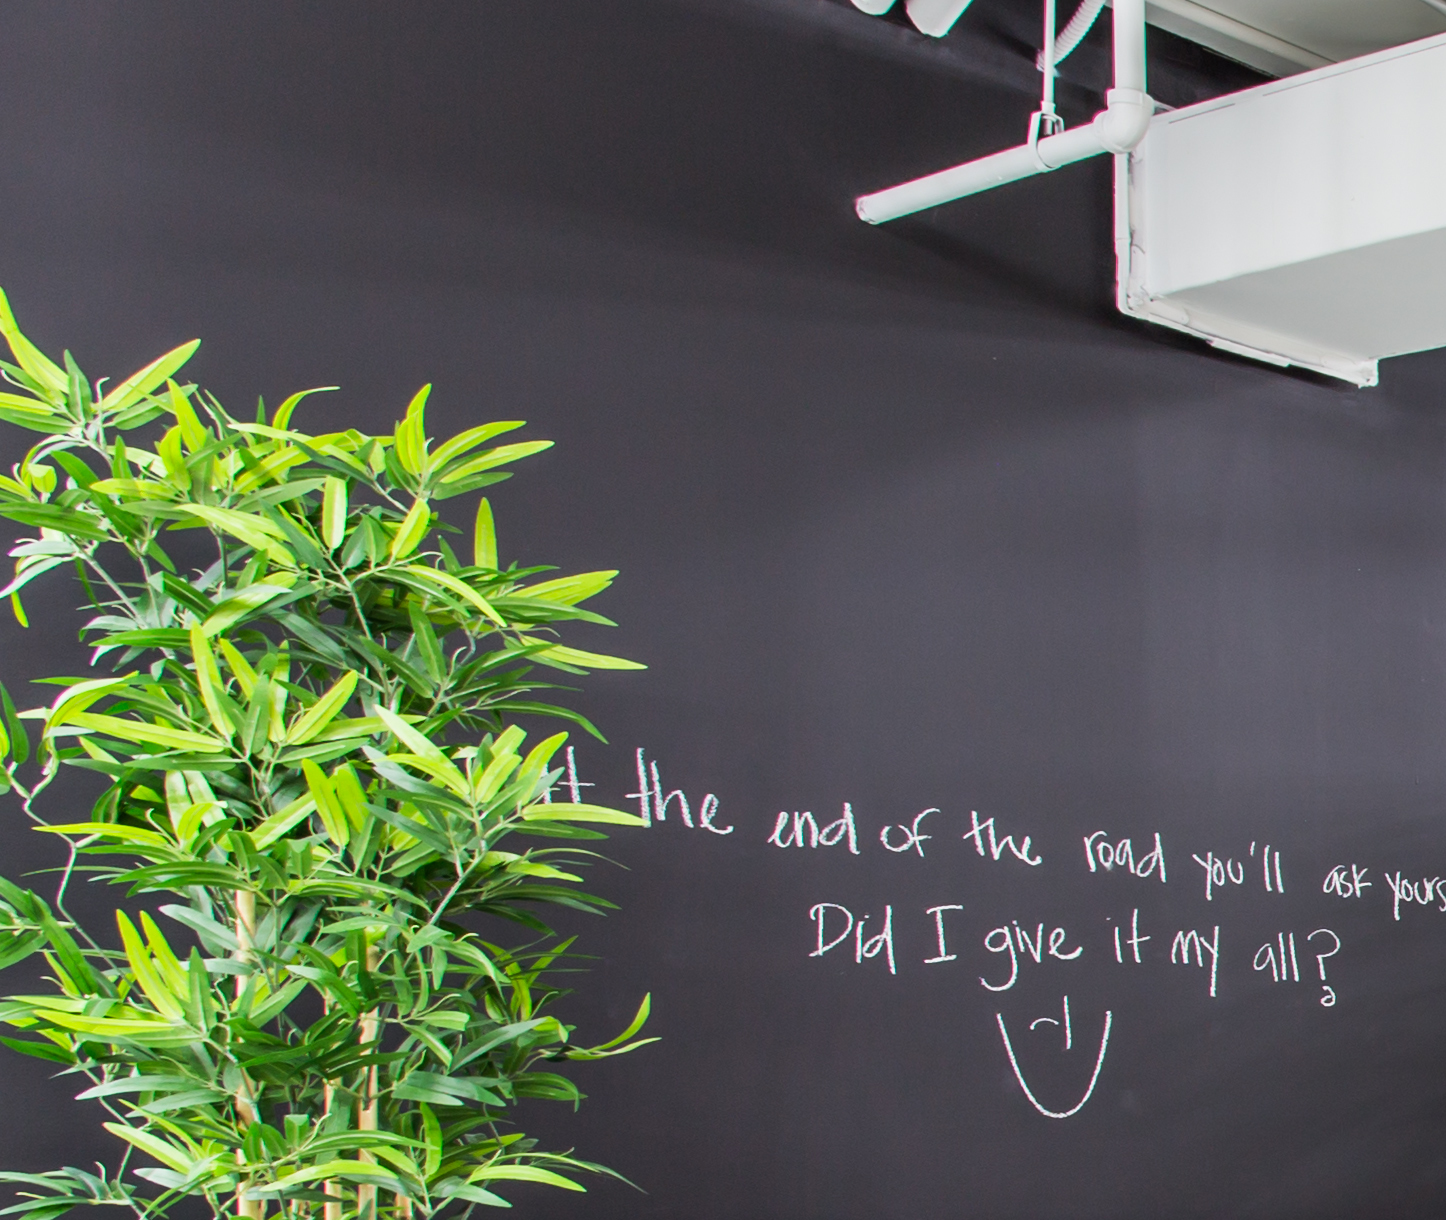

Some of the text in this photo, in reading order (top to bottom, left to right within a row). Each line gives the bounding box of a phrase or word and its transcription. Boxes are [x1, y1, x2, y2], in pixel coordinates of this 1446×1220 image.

[624, 746, 734, 835] the
[767, 802, 860, 855] end
[880, 808, 940, 857] of
[963, 811, 1042, 866] the
[1084, 830, 1167, 883] road
[1192, 841, 1284, 900] you'll
[1323, 864, 1373, 898] ask
[809, 902, 1341, 1007] Did I give it my all?
